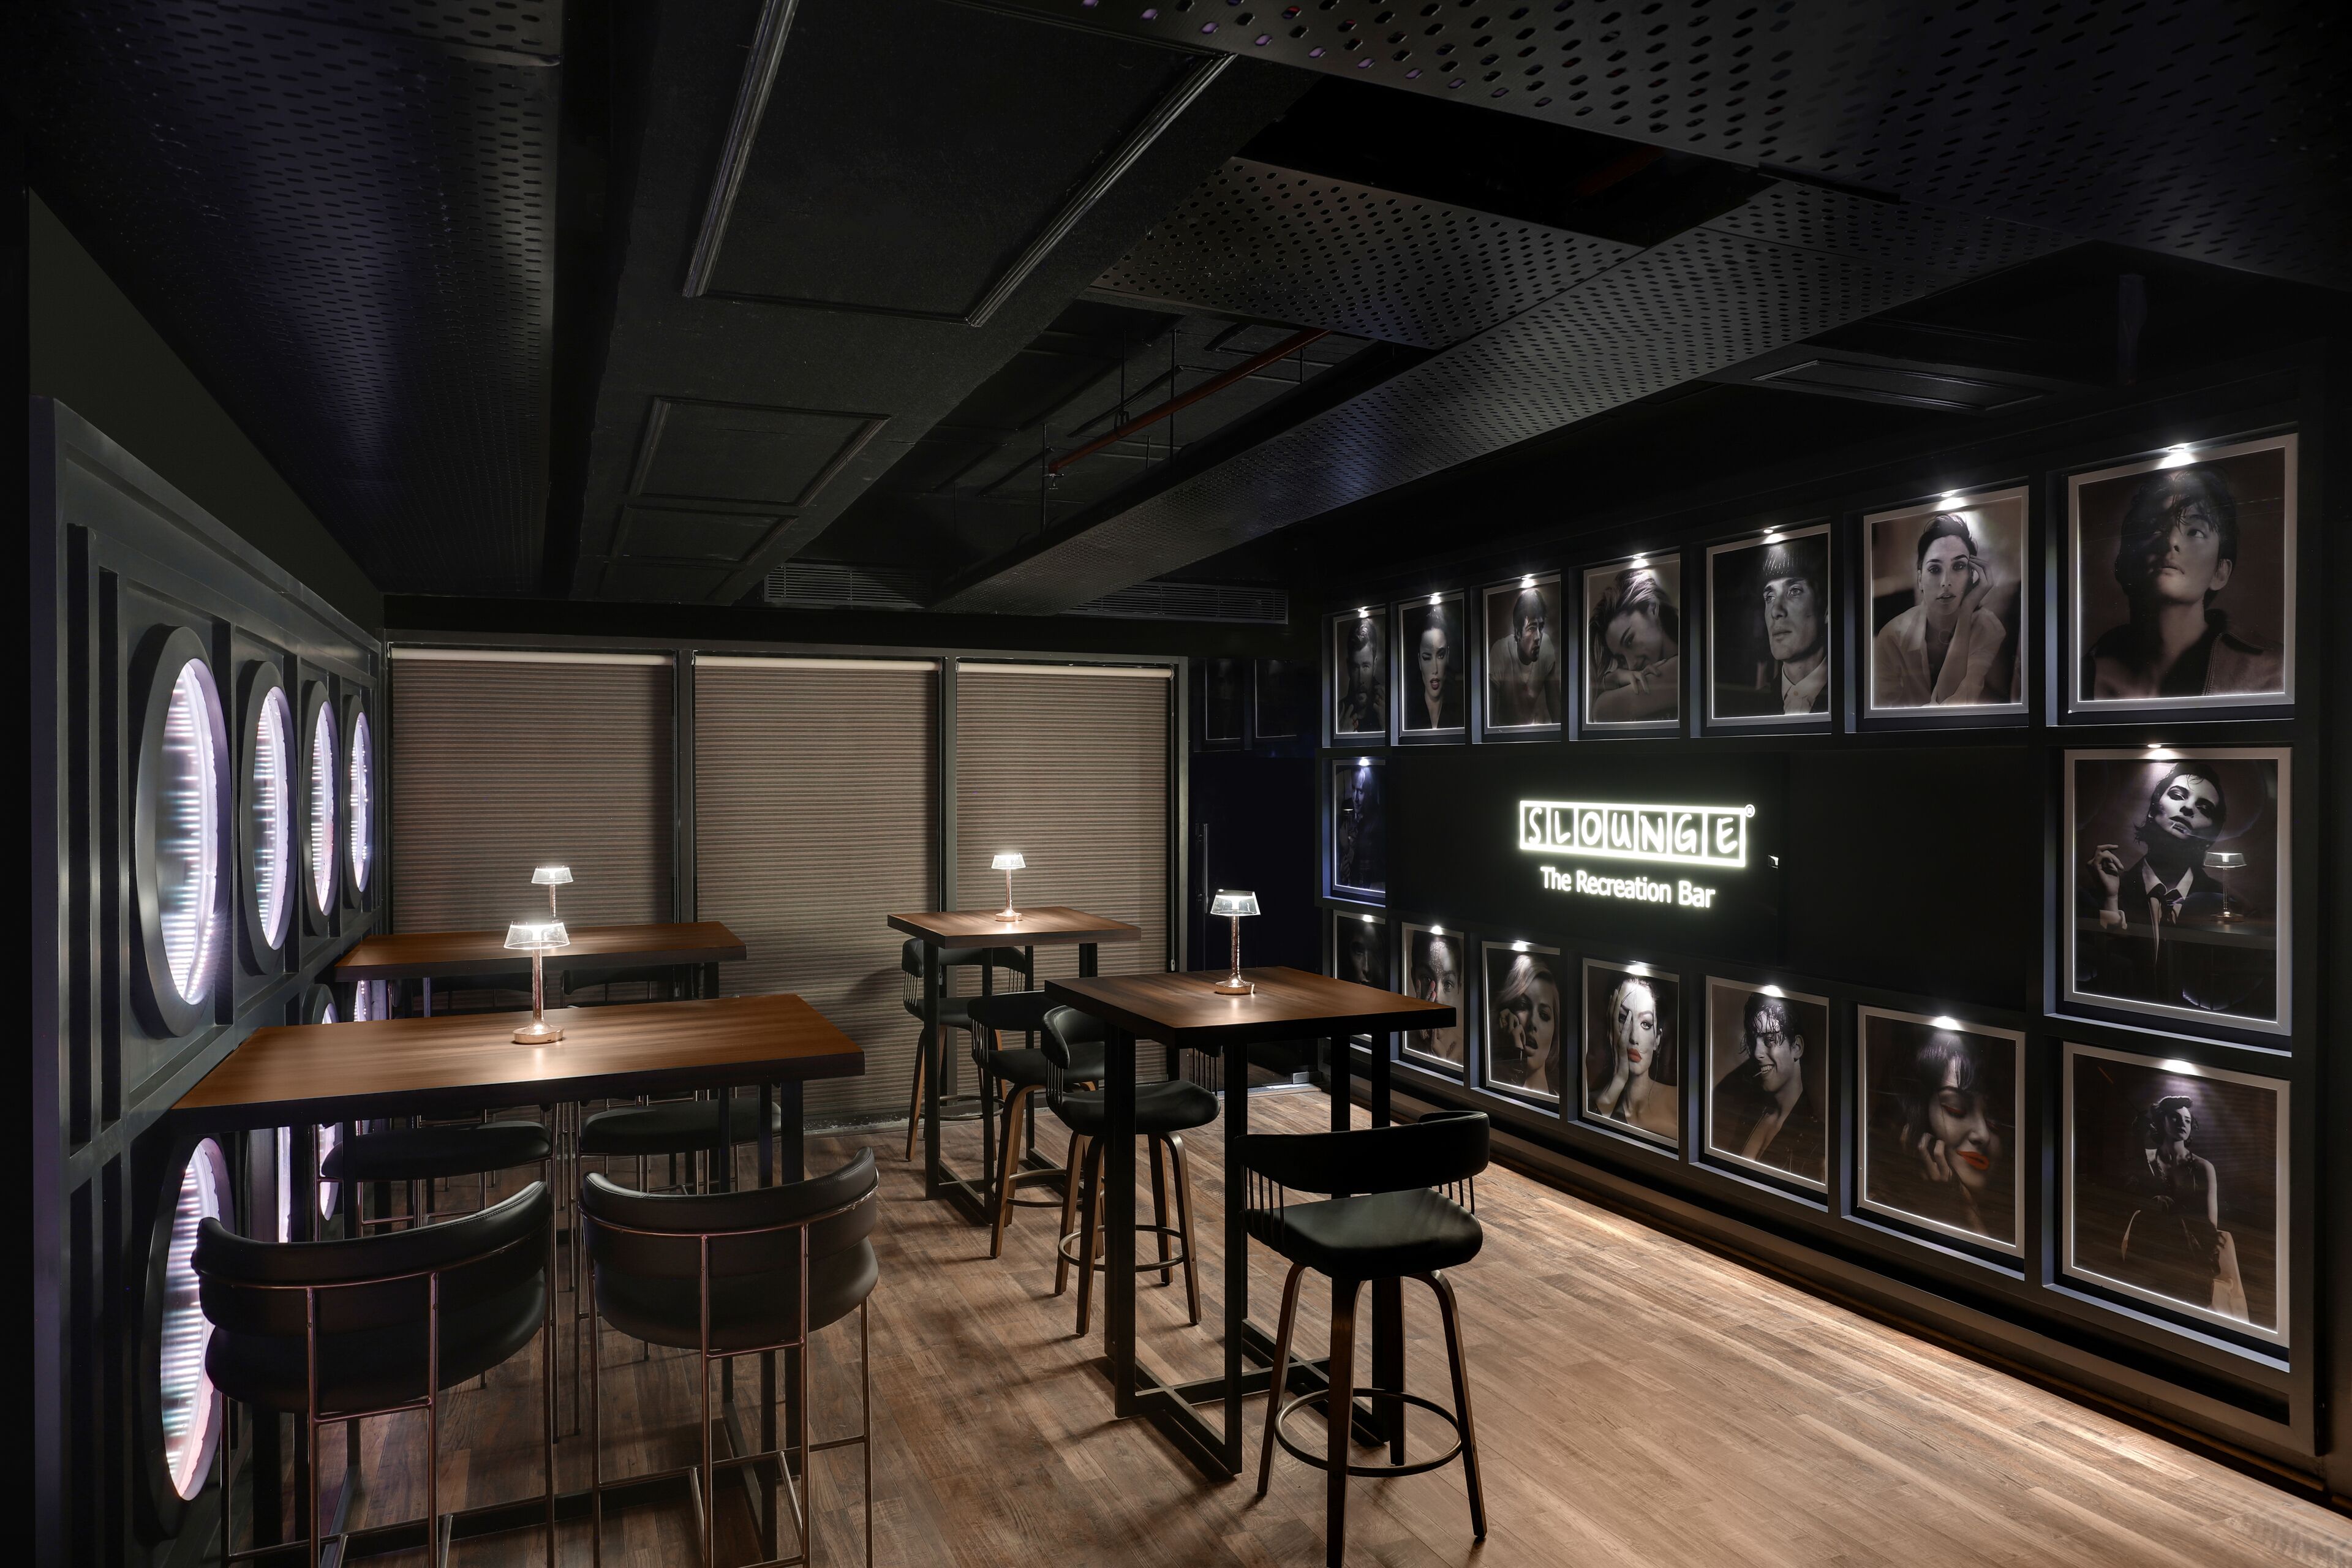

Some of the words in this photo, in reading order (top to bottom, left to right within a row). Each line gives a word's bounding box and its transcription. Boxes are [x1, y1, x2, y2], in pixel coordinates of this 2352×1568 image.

[1528, 807, 1738, 854] SLOUNGE
[1540, 865, 1572, 892] The
[1575, 869, 1672, 904] Recreation
[1677, 879, 1717, 908] Bar
